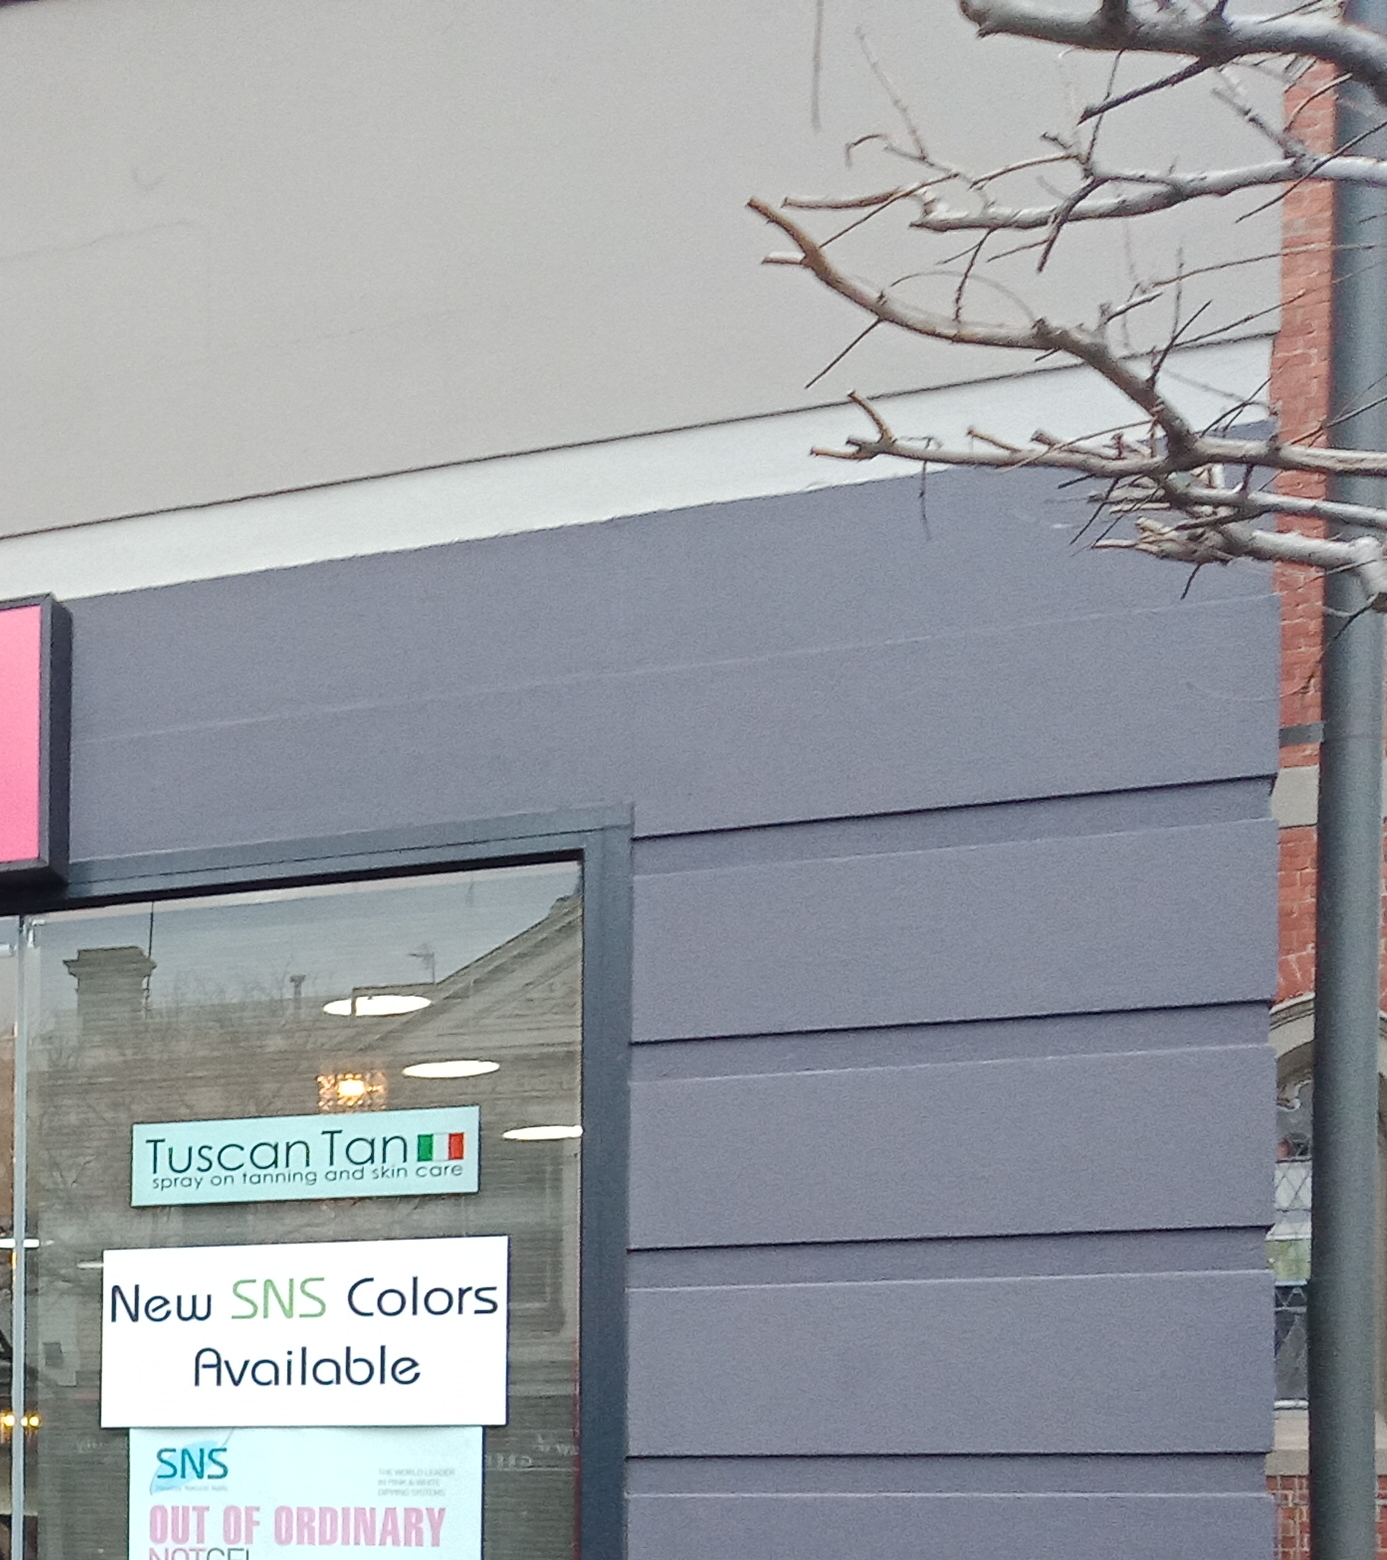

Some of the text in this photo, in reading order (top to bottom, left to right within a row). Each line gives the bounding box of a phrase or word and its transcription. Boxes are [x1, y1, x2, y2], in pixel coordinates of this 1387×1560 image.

[145, 1129, 408, 1176] Tuscan Tan
[152, 1162, 464, 1192] spray on tanning and skin care
[110, 1275, 499, 1323] New SNS Colors
[194, 1345, 421, 1387] Available
[156, 1448, 229, 1480] SNS
[149, 1504, 447, 1548] OUT OF ORDINARY
